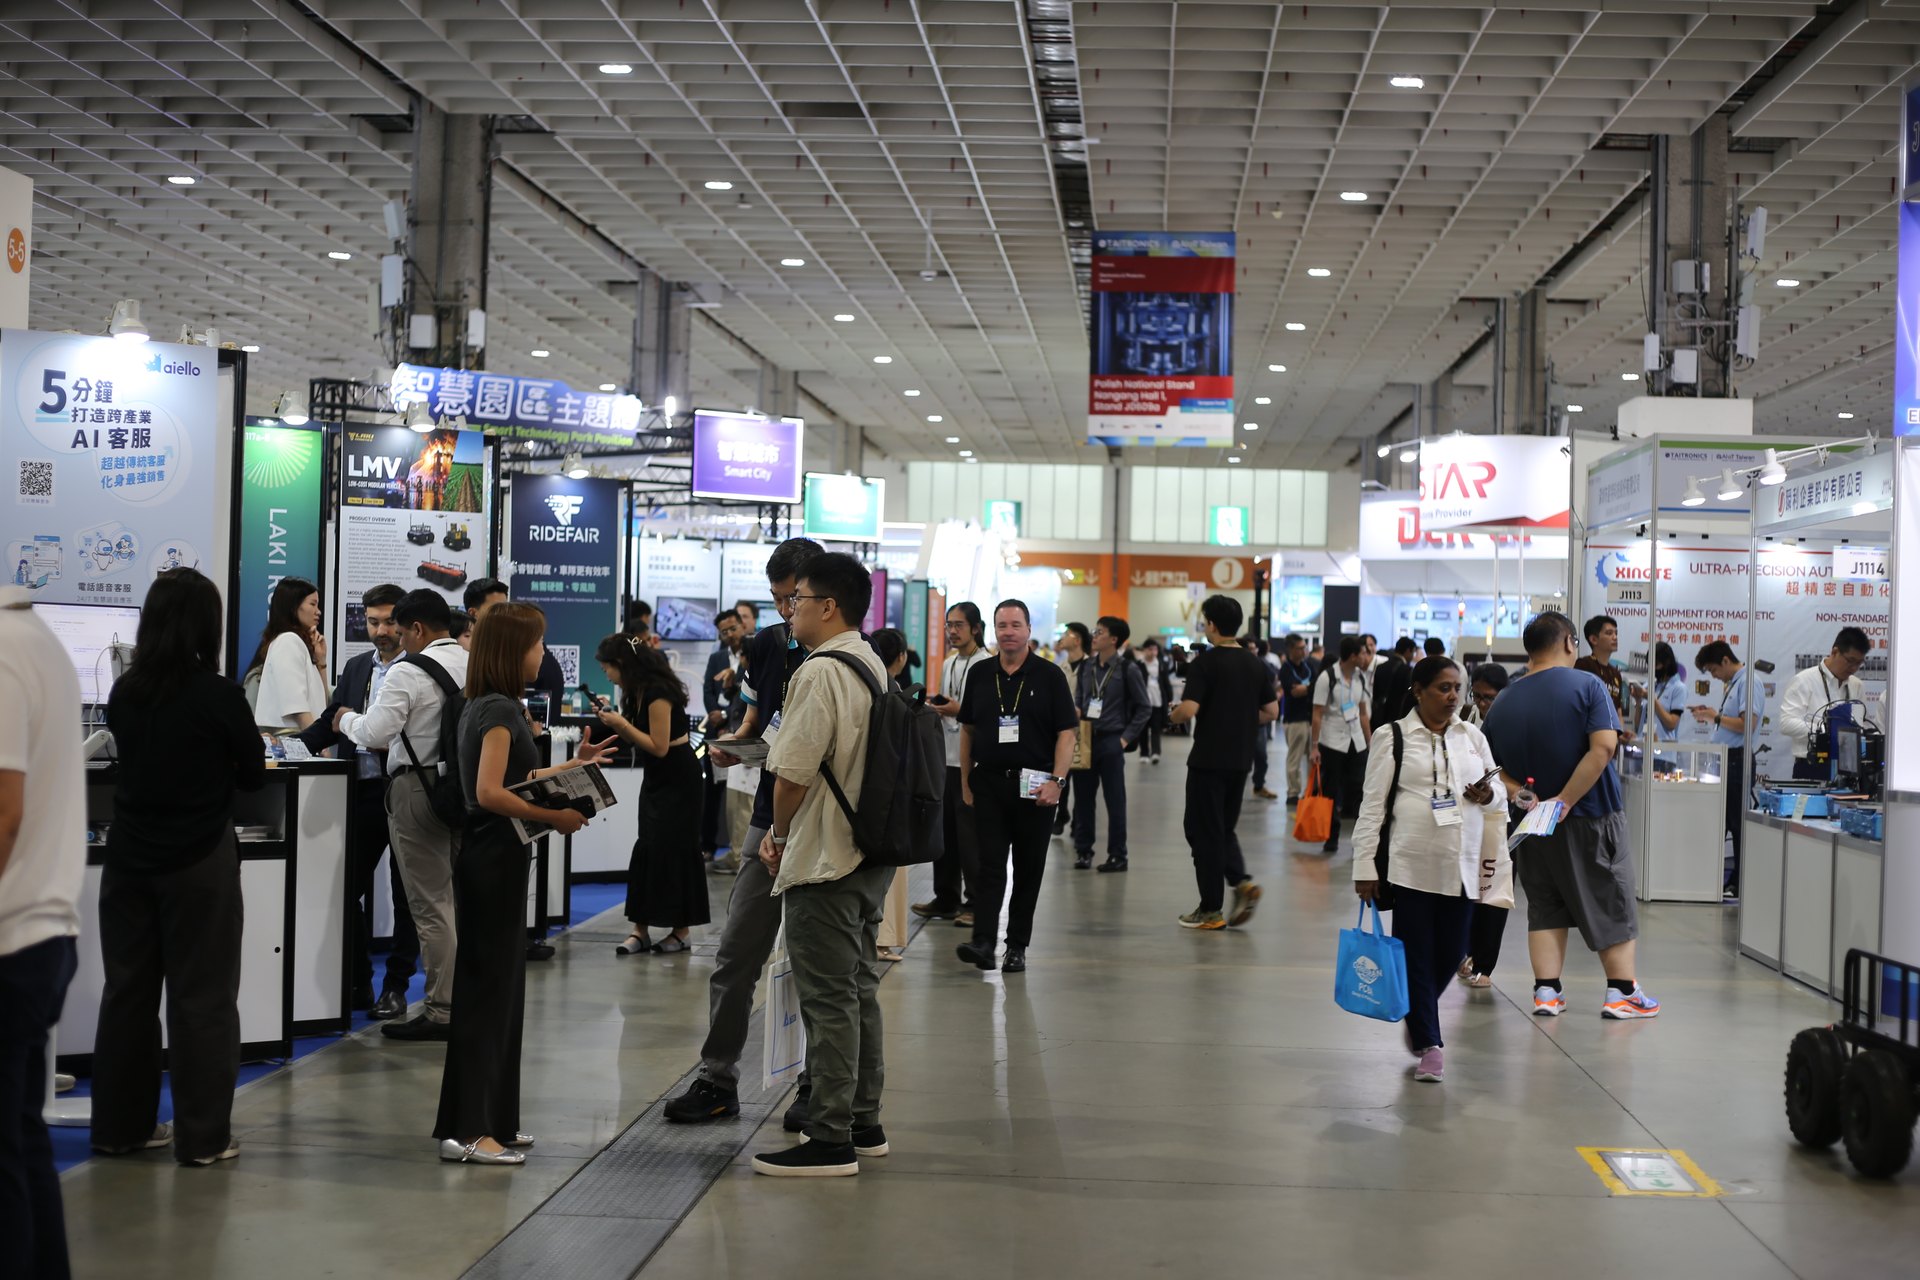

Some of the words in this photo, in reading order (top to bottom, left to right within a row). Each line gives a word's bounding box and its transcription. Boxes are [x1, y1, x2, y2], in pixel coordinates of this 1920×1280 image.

[163, 361, 201, 377] aiello
[71, 407, 152, 425] 打造跨產業
[71, 429, 99, 449] AI
[107, 427, 152, 450] 客服
[348, 454, 402, 479] LMV
[724, 465, 752, 479] Smart
[753, 467, 773, 483] City
[268, 508, 288, 565] LAKI
[529, 525, 600, 543] RIDEFAIR
[1222, 562, 1233, 585] J
[1851, 562, 1885, 575] J1114
[1619, 591, 1642, 600] J1113
[1605, 607, 1647, 617] WINDING
[1655, 609, 1704, 619] QUIPMENT
[1706, 610, 1724, 618] FOR
[1727, 610, 1775, 620] MAGETIC
[1657, 621, 1724, 631] COMPONENTS
